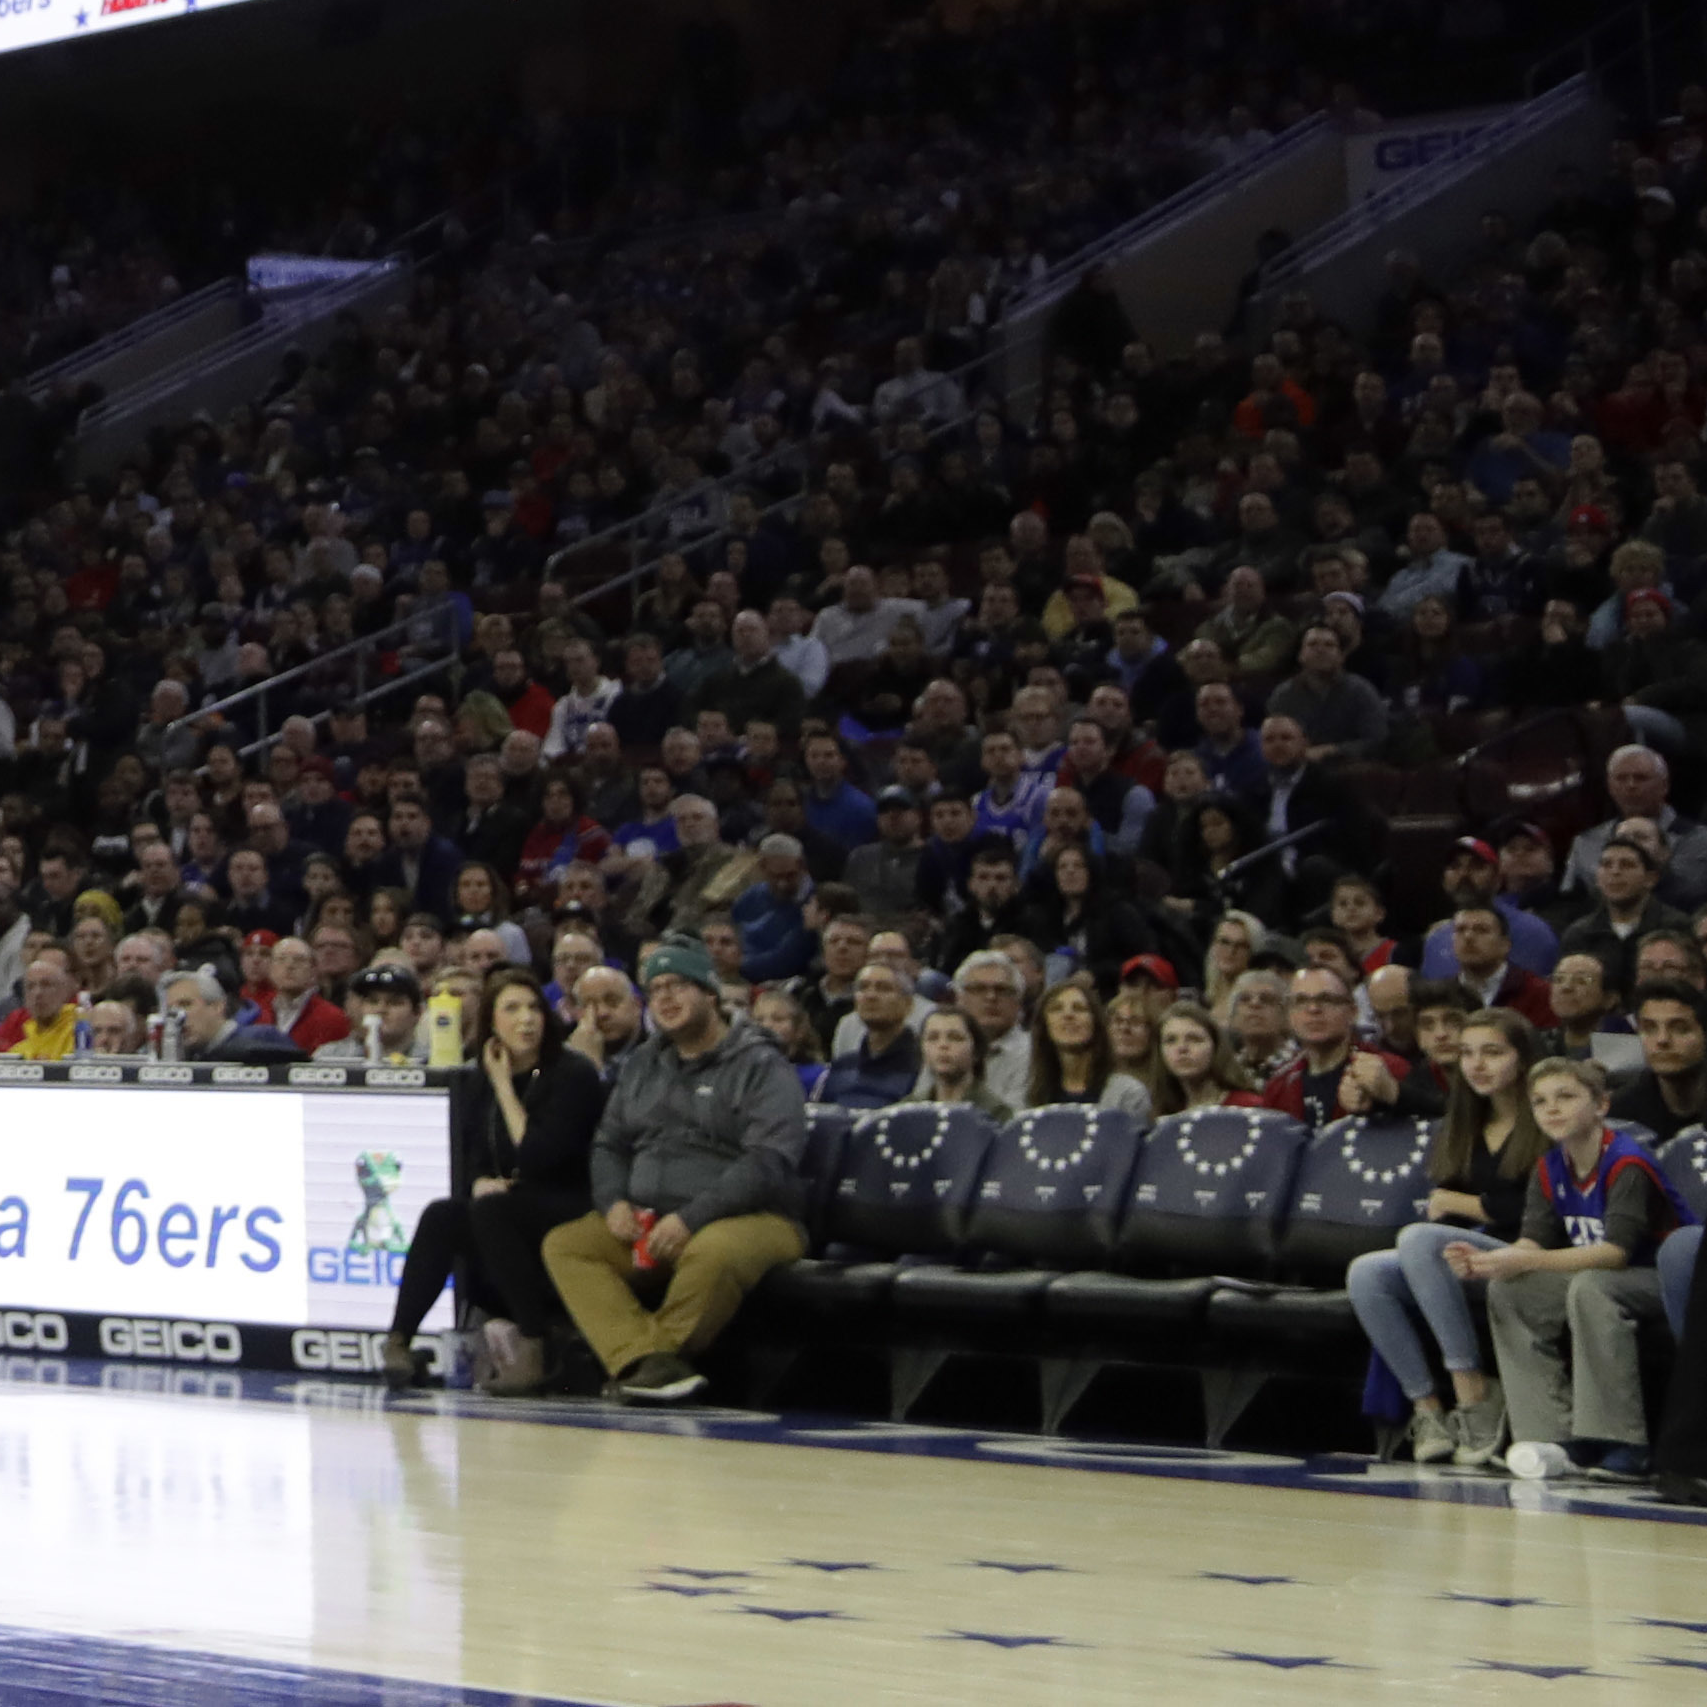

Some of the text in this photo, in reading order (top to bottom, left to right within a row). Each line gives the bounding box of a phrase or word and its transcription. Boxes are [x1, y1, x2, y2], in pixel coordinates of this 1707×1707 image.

[138, 1066, 193, 1083] GEICO
[212, 1066, 268, 1083] GEICO
[289, 1067, 347, 1084] GEICO
[366, 1068, 425, 1086] GEICO
[64, 1179, 284, 1273] 76ers
[99, 1317, 243, 1363] GEICO
